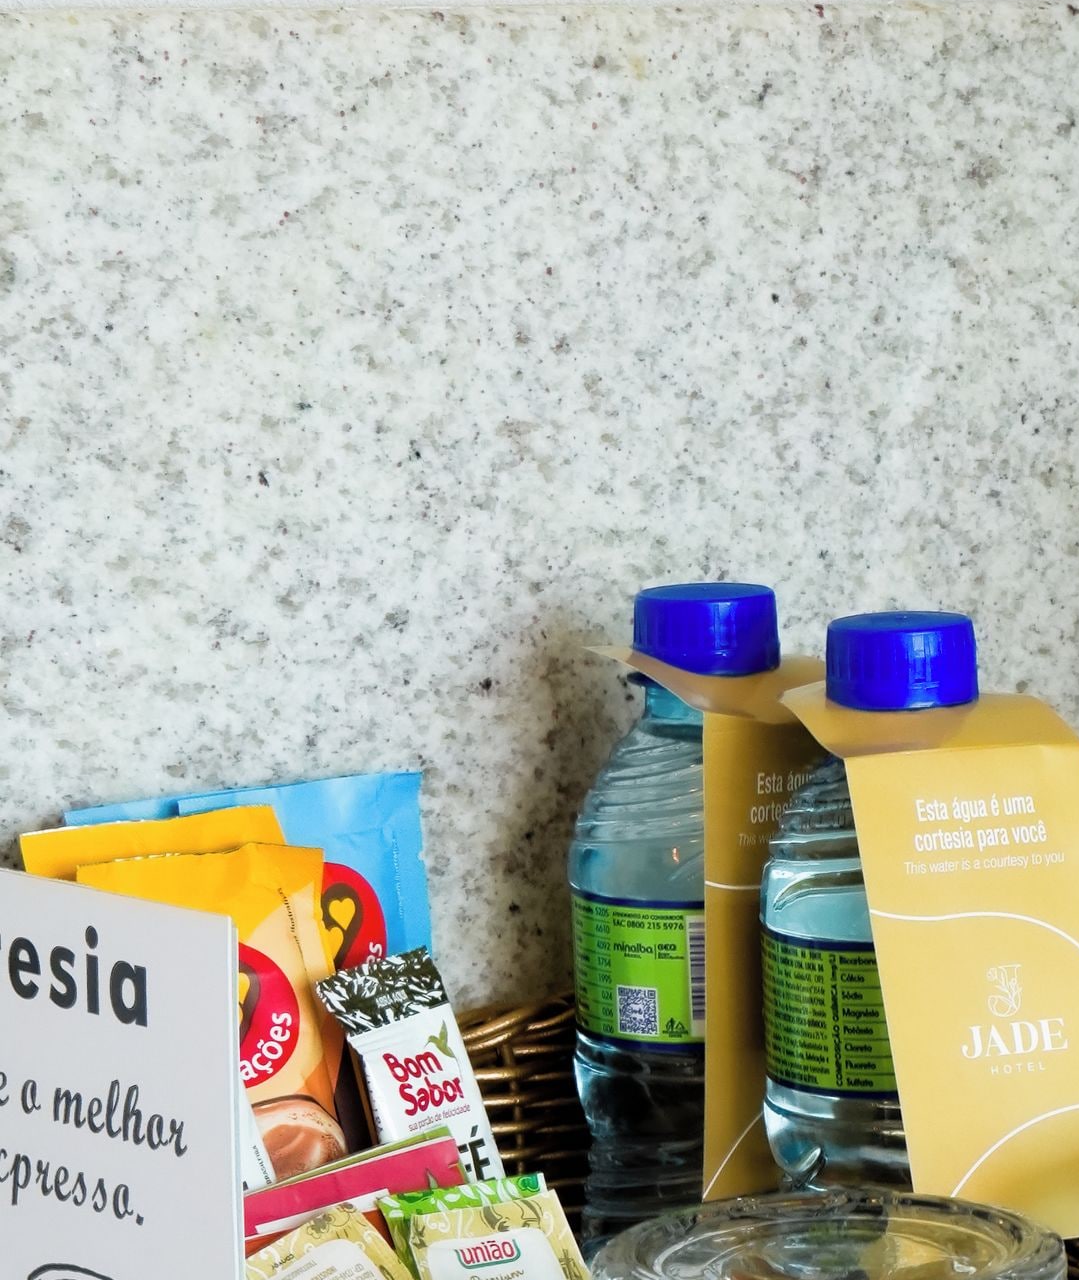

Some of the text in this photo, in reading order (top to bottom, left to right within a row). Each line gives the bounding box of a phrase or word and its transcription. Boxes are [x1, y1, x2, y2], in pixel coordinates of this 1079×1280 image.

[757, 772, 783, 795] Esta
[915, 793, 1036, 823] Esta água é uma
[914, 820, 1047, 852] cortesia para você
[904, 851, 1065, 875] This water is a courtesy to you
[627, 921, 645, 929] 0800
[647, 922, 661, 930] 215
[663, 923, 684, 931] 5976
[613, 941, 653, 955] minalba
[0, 925, 147, 1027] esia
[840, 972, 865, 983] Cálcio
[841, 990, 863, 1000] Sódio
[842, 1007, 879, 1019] Magnésio
[843, 1025, 874, 1035] Potássio
[961, 1017, 1068, 1059] JADE
[844, 1043, 872, 1053] Cloreto
[382, 1051, 443, 1083] Bom
[845, 1061, 876, 1070] Fluoreto
[991, 1061, 1047, 1075] HOTEL
[846, 1077, 874, 1087] Sulfato
[399, 1075, 465, 1117] Sabor
[53, 1079, 188, 1158] melhor
[408, 1122, 419, 1133] sua
[460, 1239, 515, 1266] união
